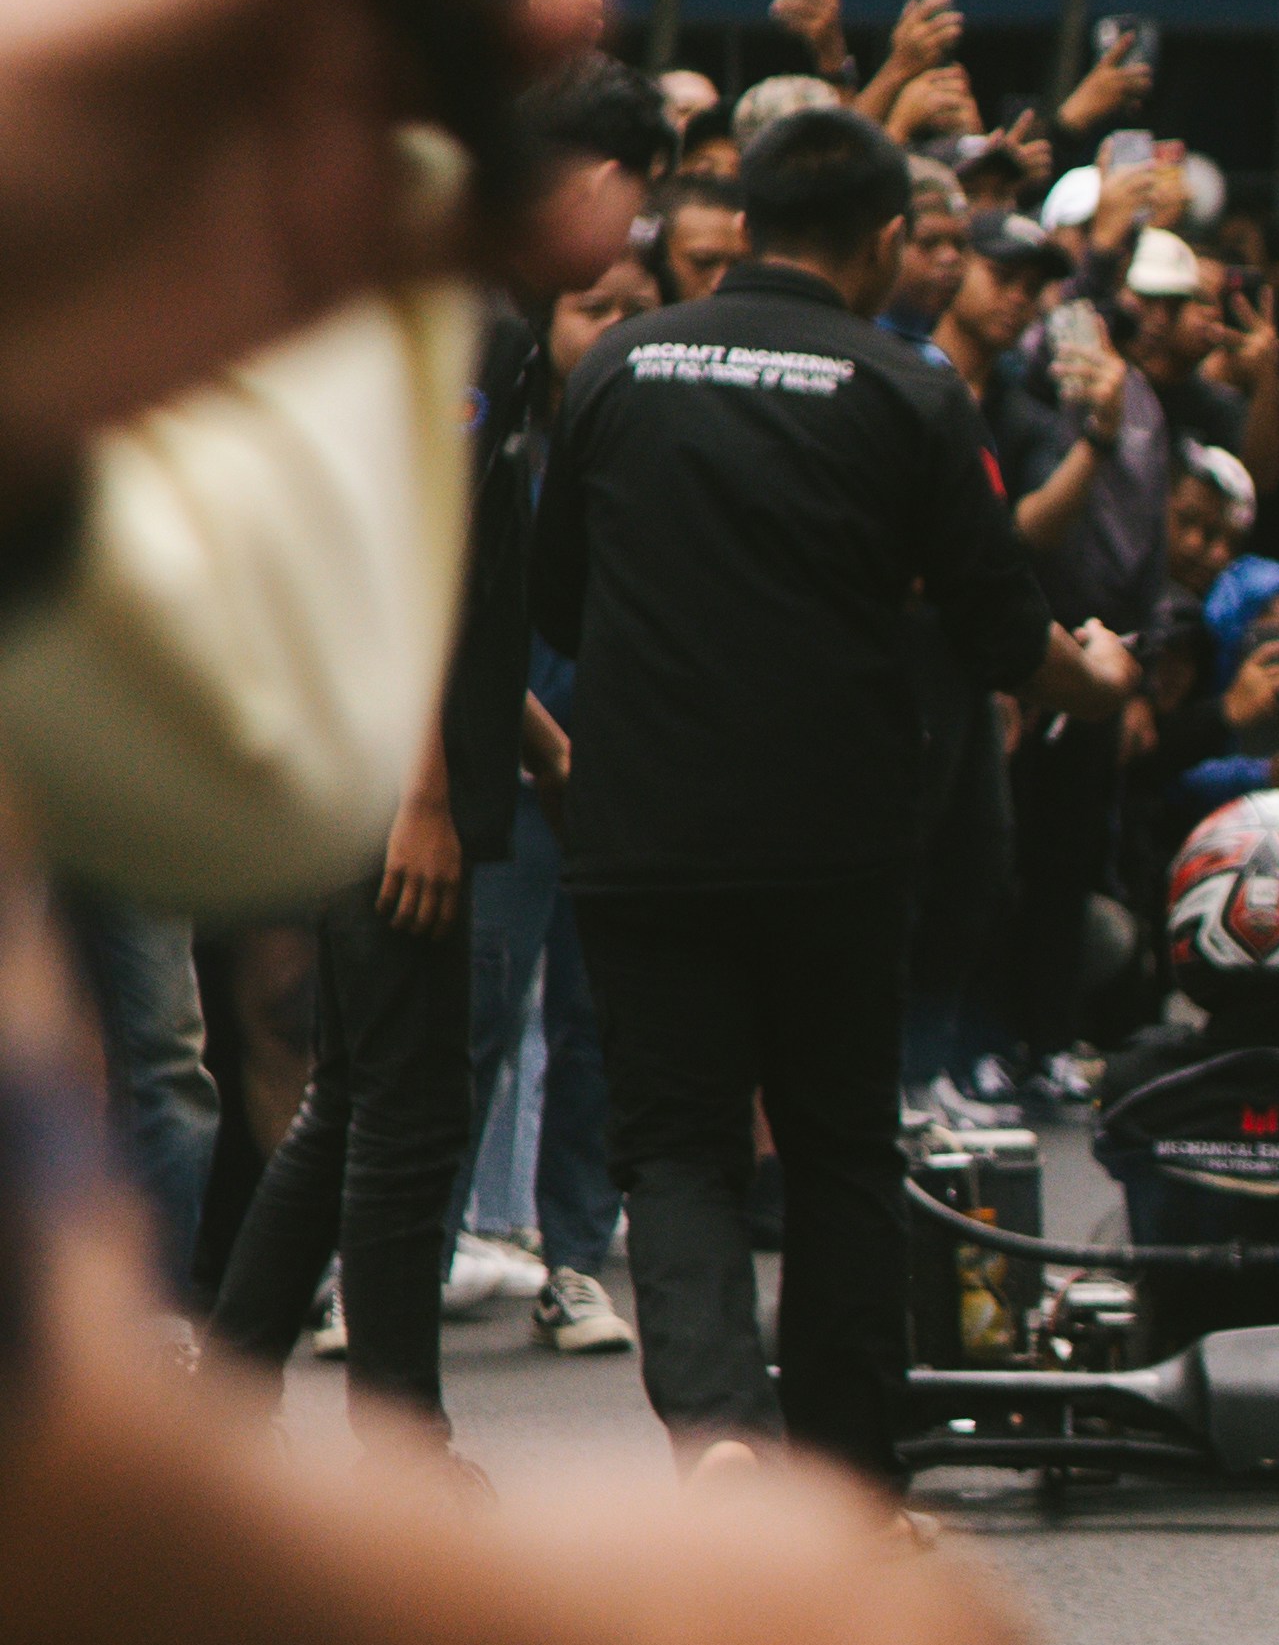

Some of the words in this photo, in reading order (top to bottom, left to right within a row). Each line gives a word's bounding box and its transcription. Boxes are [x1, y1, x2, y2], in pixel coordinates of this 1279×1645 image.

[626, 341, 726, 366] AIRCRAFT
[727, 345, 856, 383] ENGINEERING
[1155, 1140, 1254, 1157] MECHANICAL
